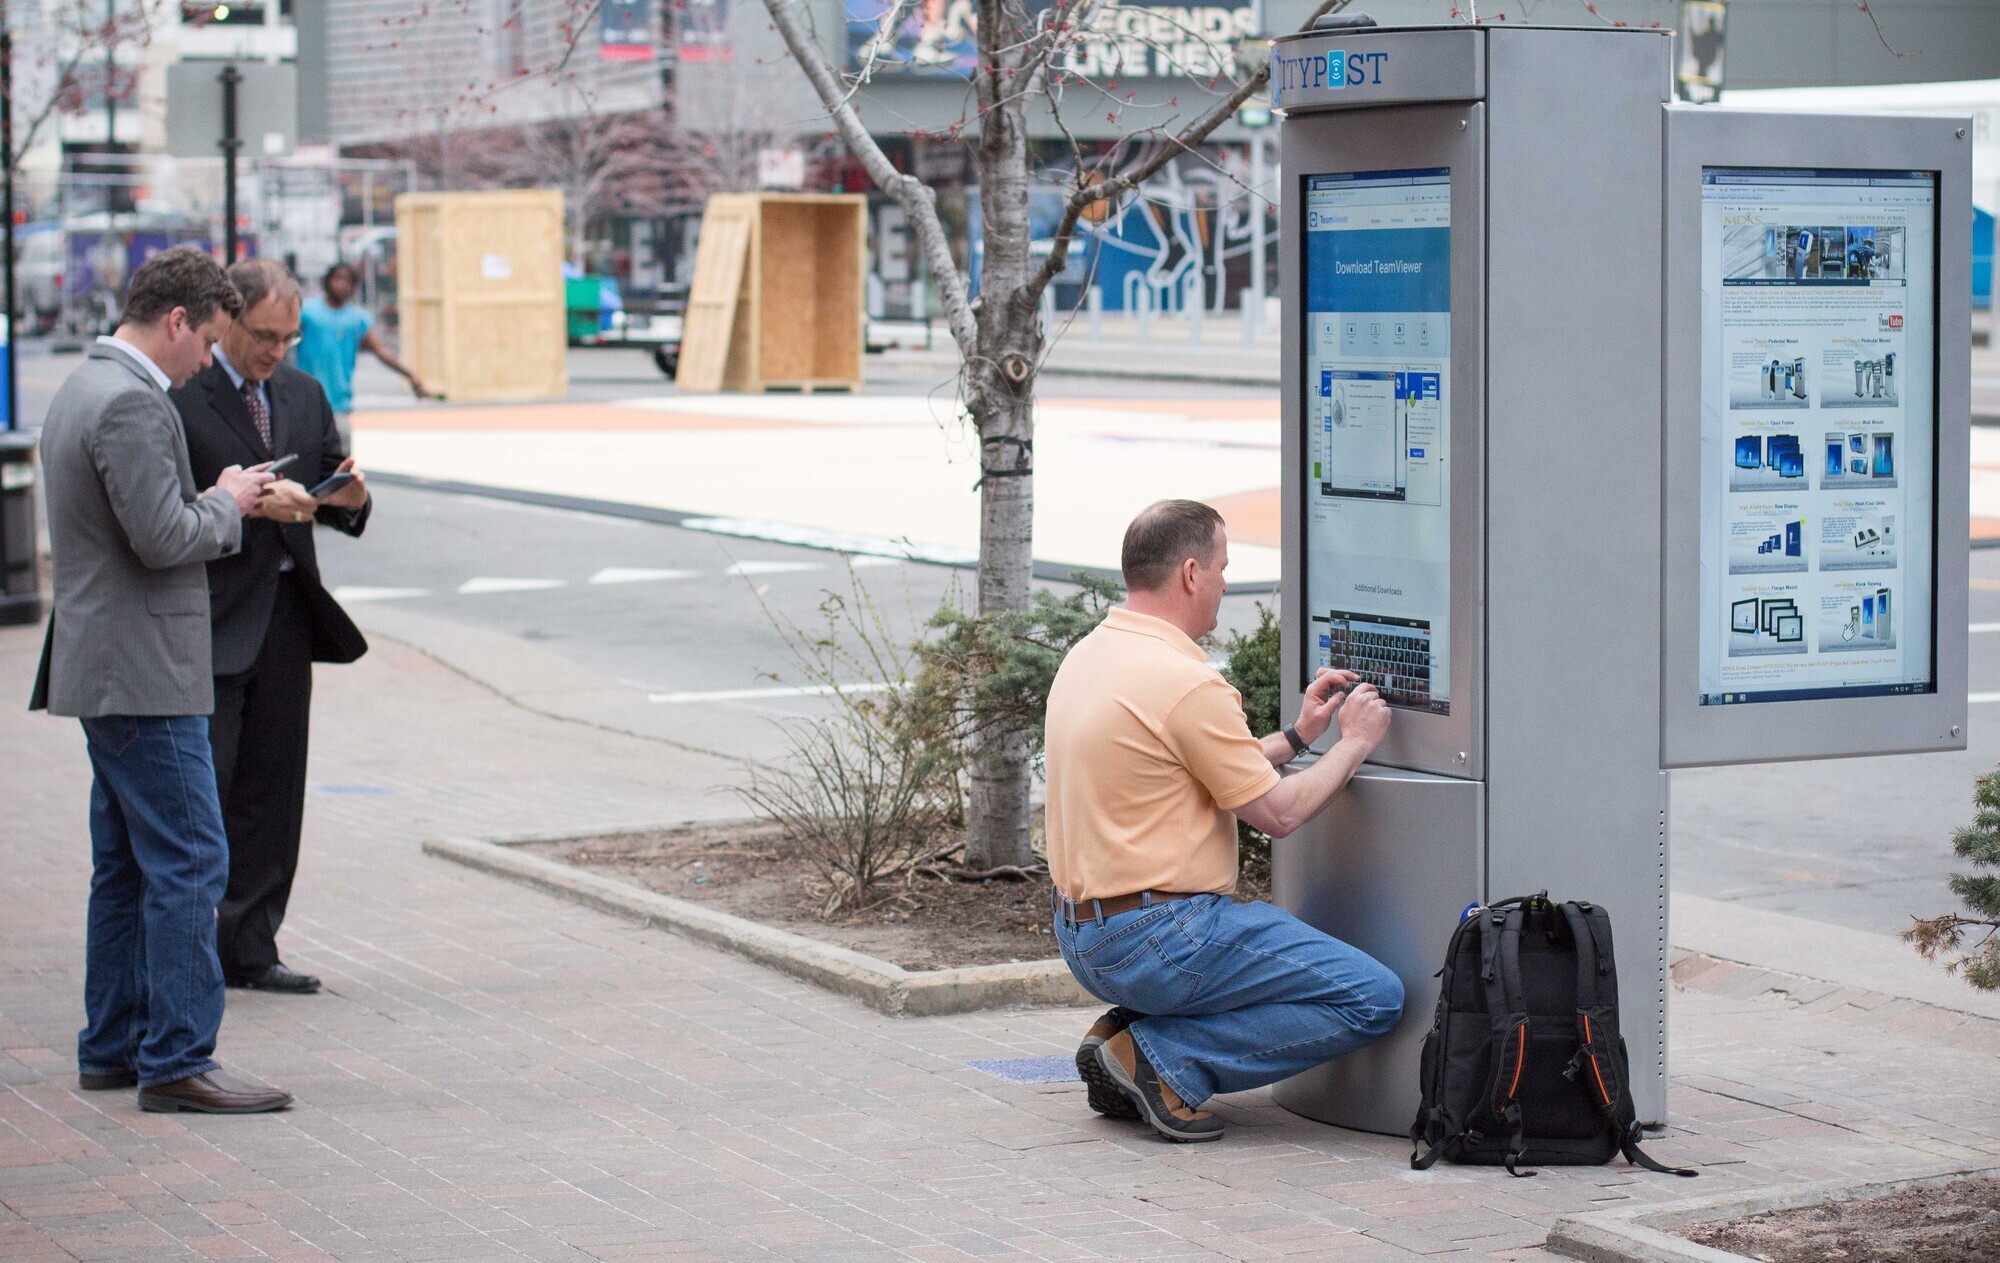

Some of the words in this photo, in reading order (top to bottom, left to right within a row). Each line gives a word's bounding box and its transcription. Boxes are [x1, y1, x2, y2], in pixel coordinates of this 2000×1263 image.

[1064, 41, 1149, 77] LIVE
[1336, 260, 1372, 274] Download
[1374, 260, 1422, 274] TeamViewer
[1354, 583, 1376, 594] Additional
[1377, 585, 1402, 596] Downloads
